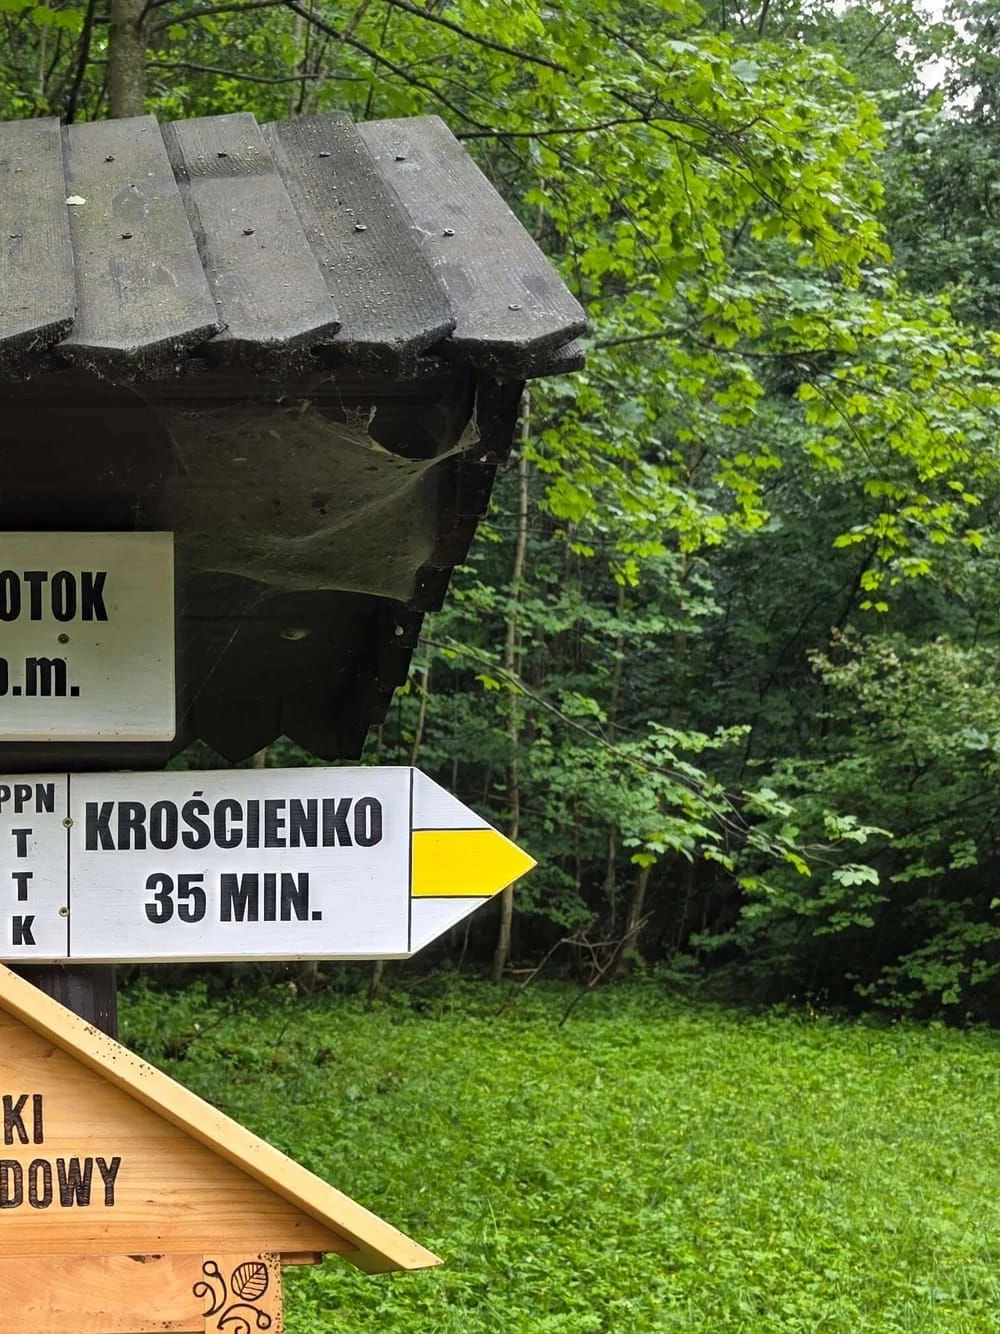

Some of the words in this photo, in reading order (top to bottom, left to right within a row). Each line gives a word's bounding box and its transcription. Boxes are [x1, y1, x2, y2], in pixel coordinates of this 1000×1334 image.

[86, 791, 382, 850] KROŚCIENKO
[145, 873, 206, 924] 35
[220, 873, 322, 922] MIN.
